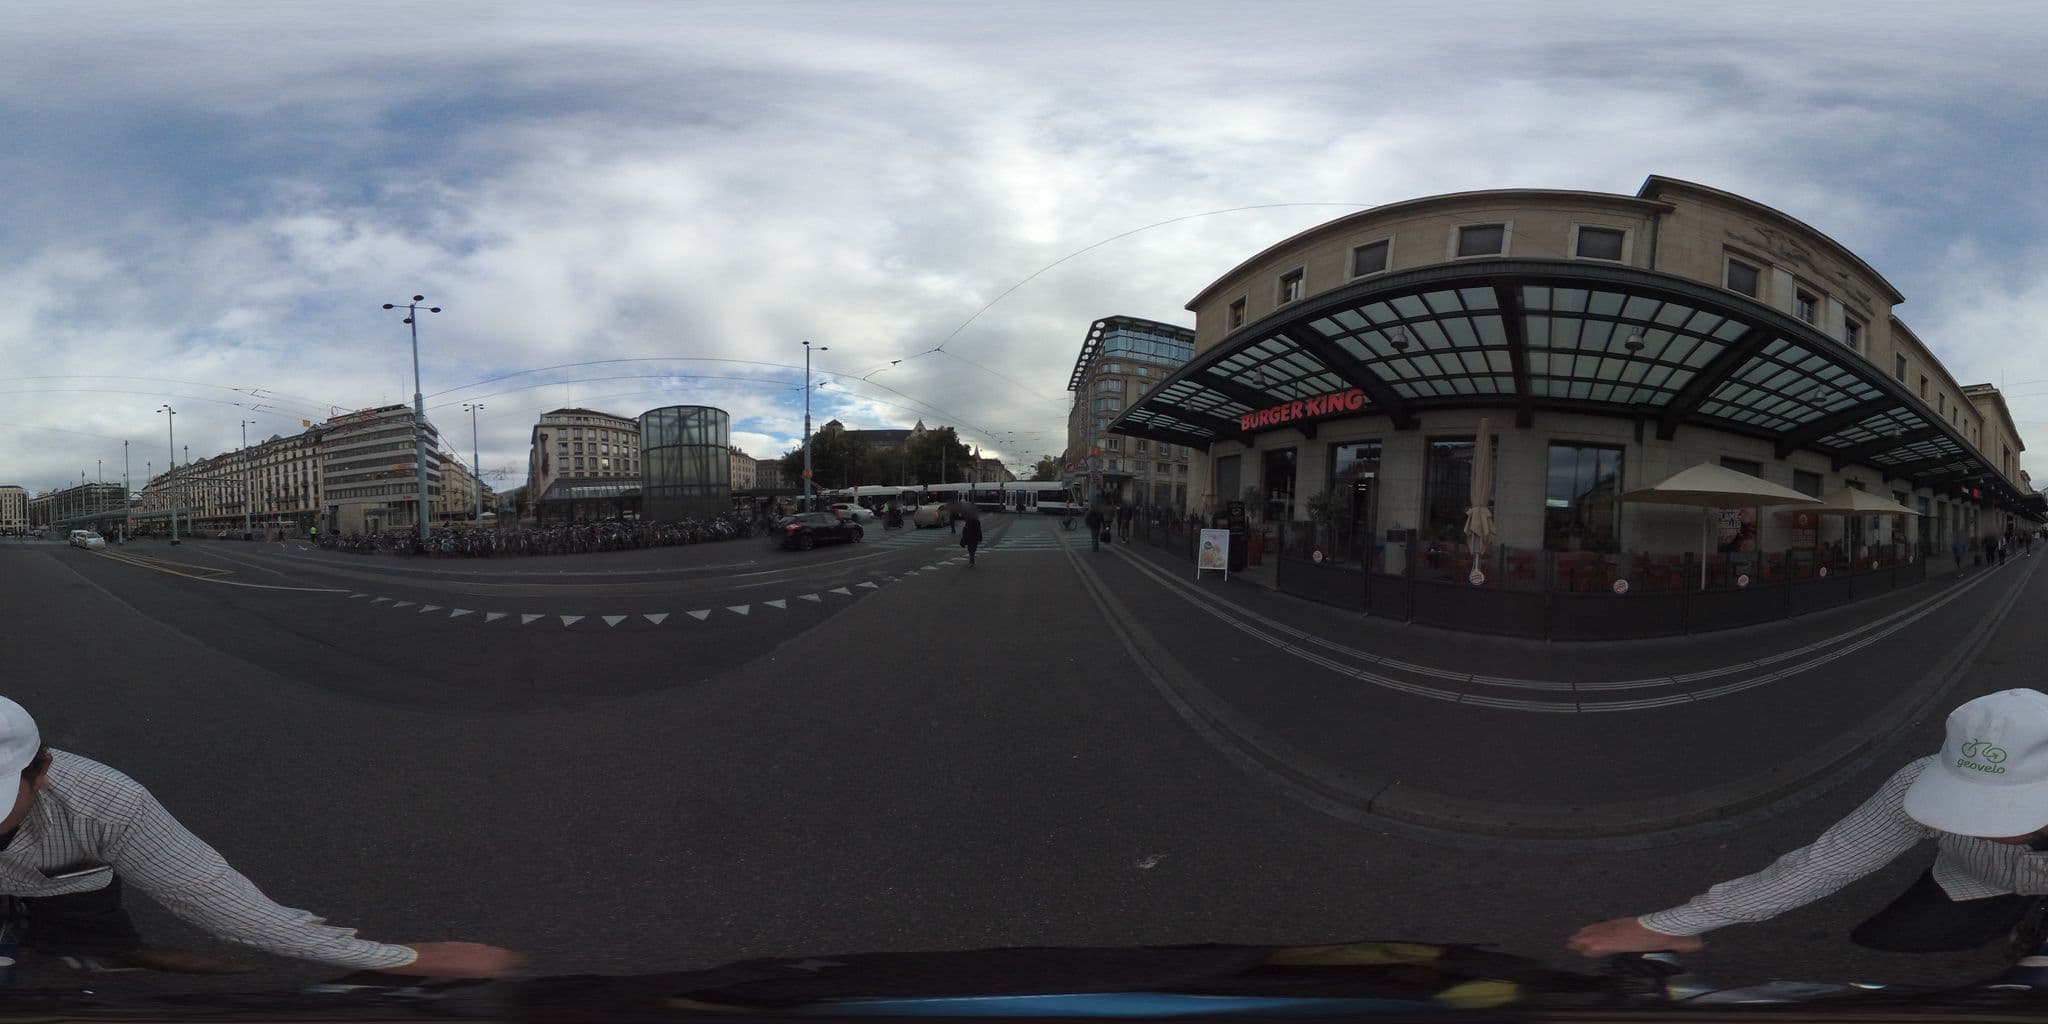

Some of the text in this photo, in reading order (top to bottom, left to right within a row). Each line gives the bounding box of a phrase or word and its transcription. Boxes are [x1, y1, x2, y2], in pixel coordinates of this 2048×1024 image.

[1240, 388, 1364, 431] BURGER KING
[1957, 759, 2005, 774] geovelo
